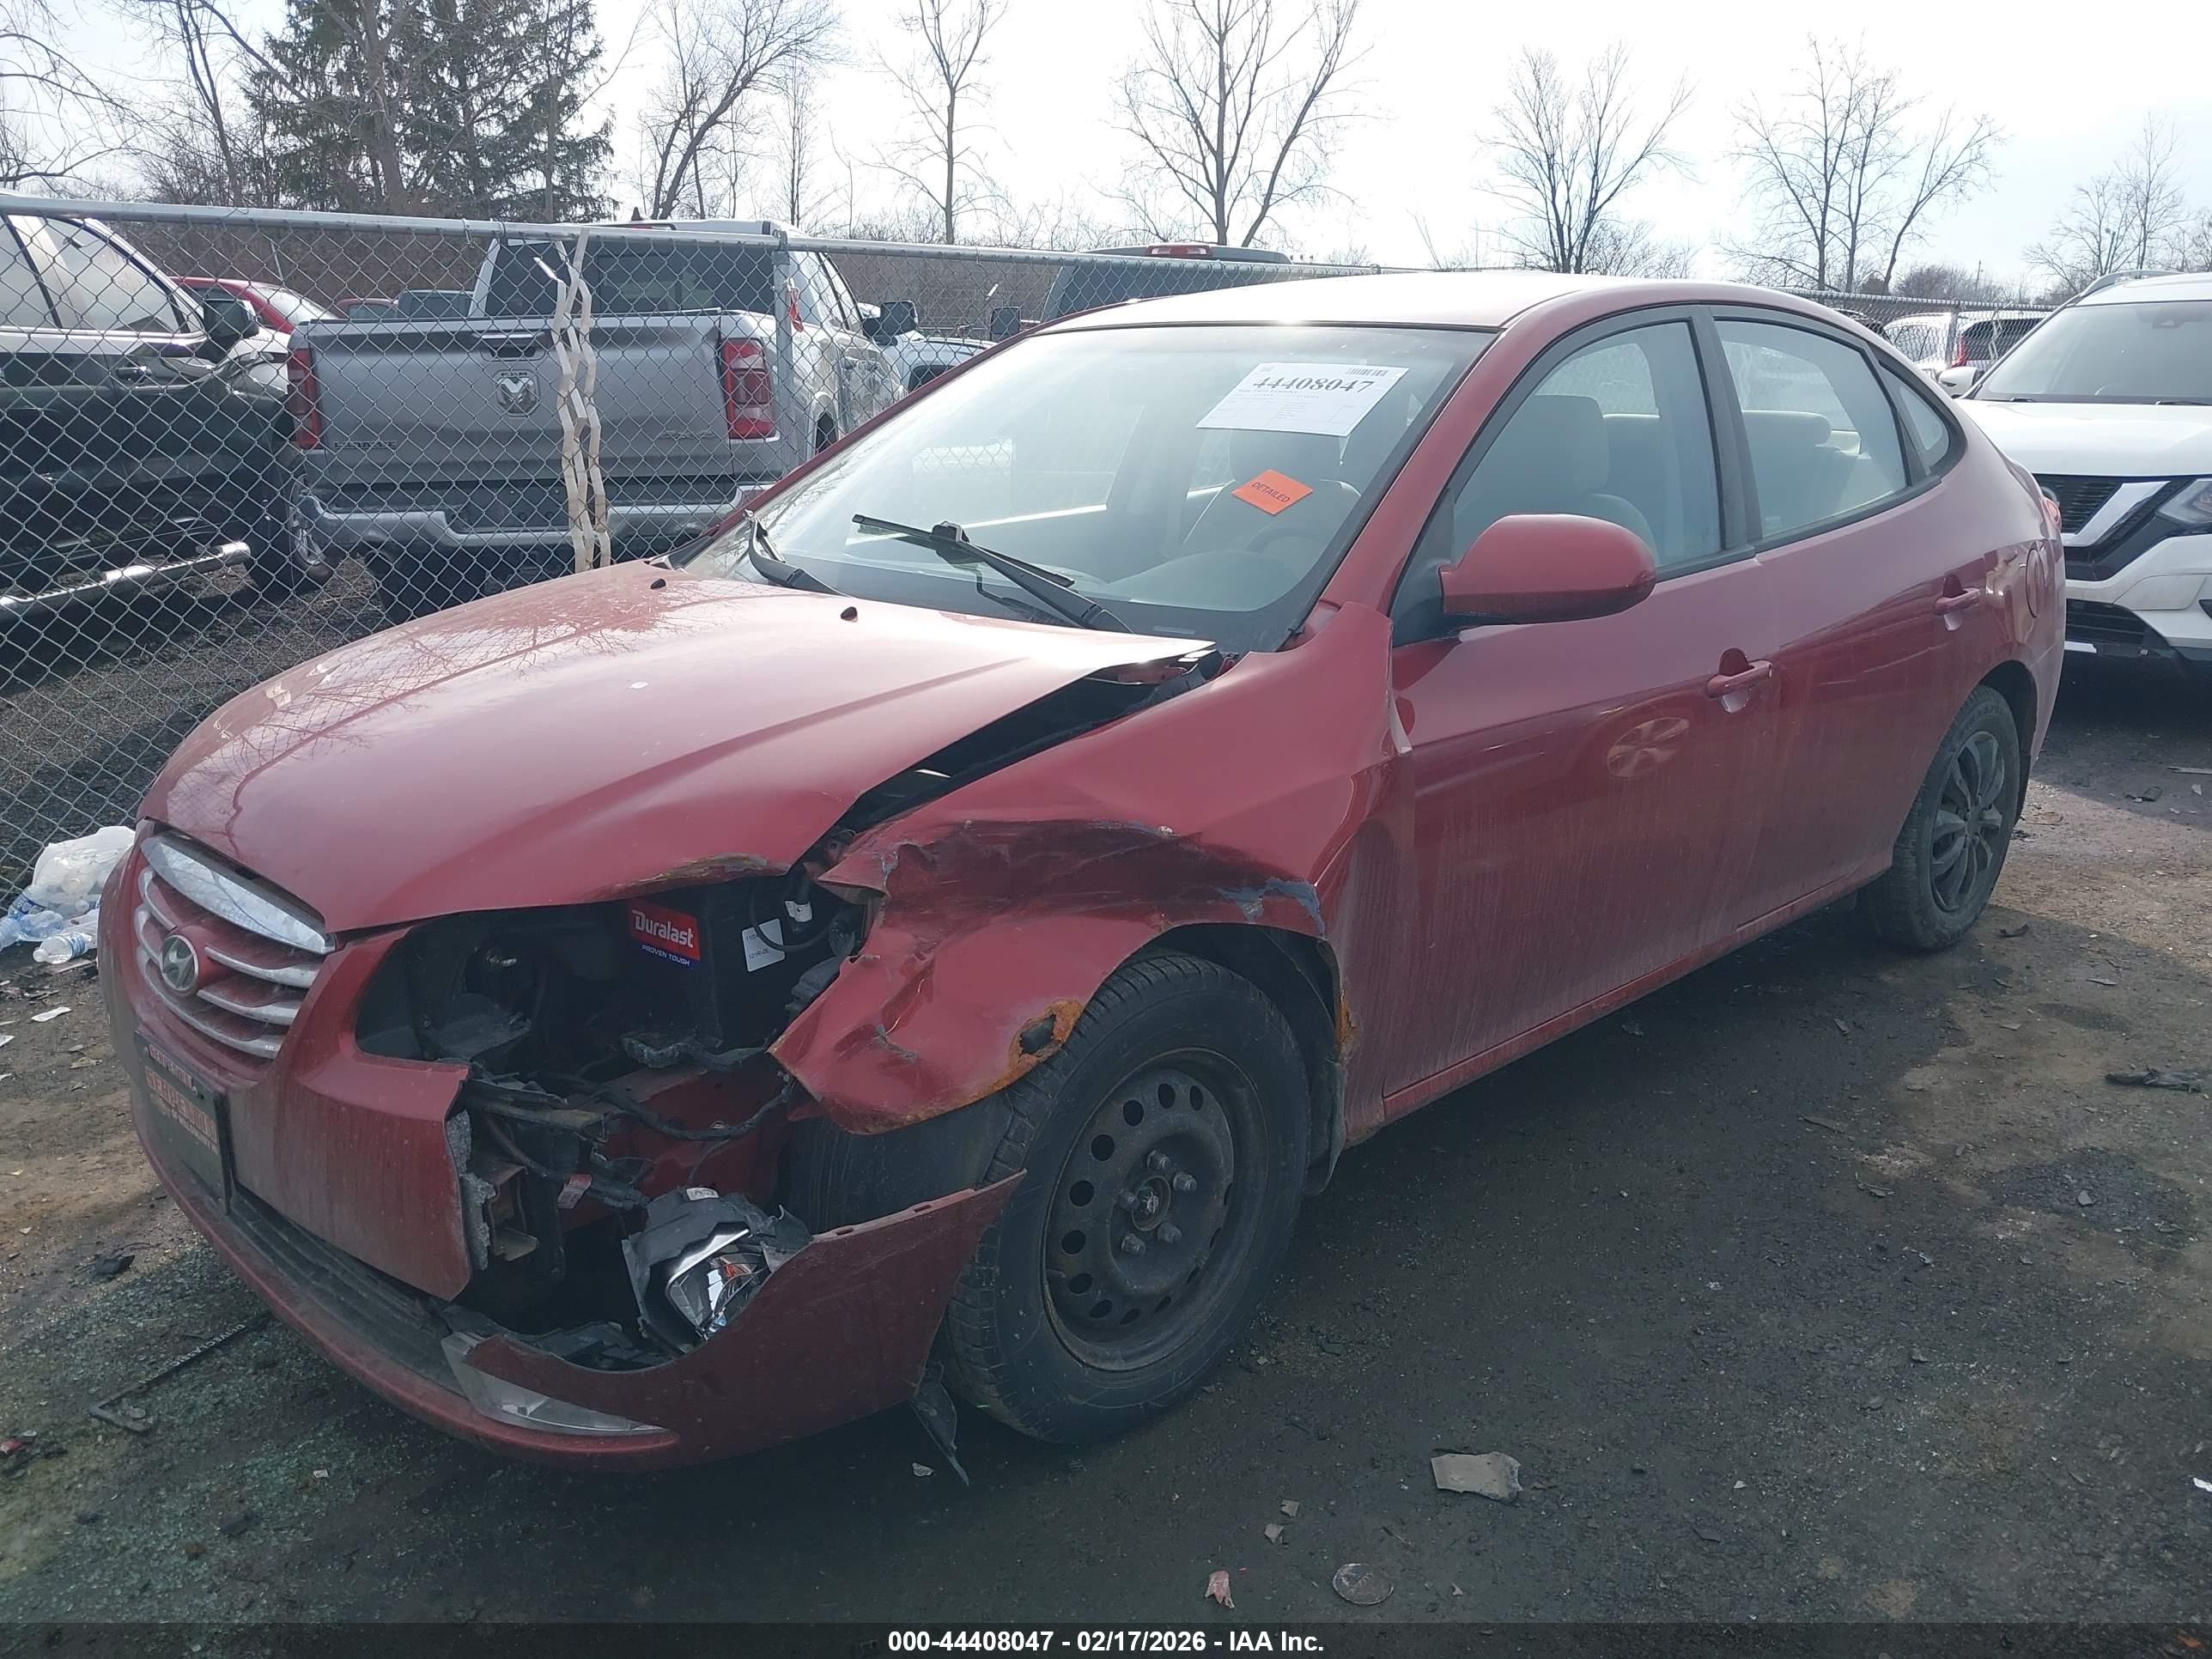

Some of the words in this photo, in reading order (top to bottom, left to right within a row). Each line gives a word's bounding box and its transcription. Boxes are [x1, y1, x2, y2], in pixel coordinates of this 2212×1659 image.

[1253, 376, 1376, 393] 44408047
[1251, 480, 1291, 504] DETAILED
[632, 909, 694, 948] Duralast
[641, 944, 667, 958] PROVEN
[669, 953, 690, 967] TOUGH
